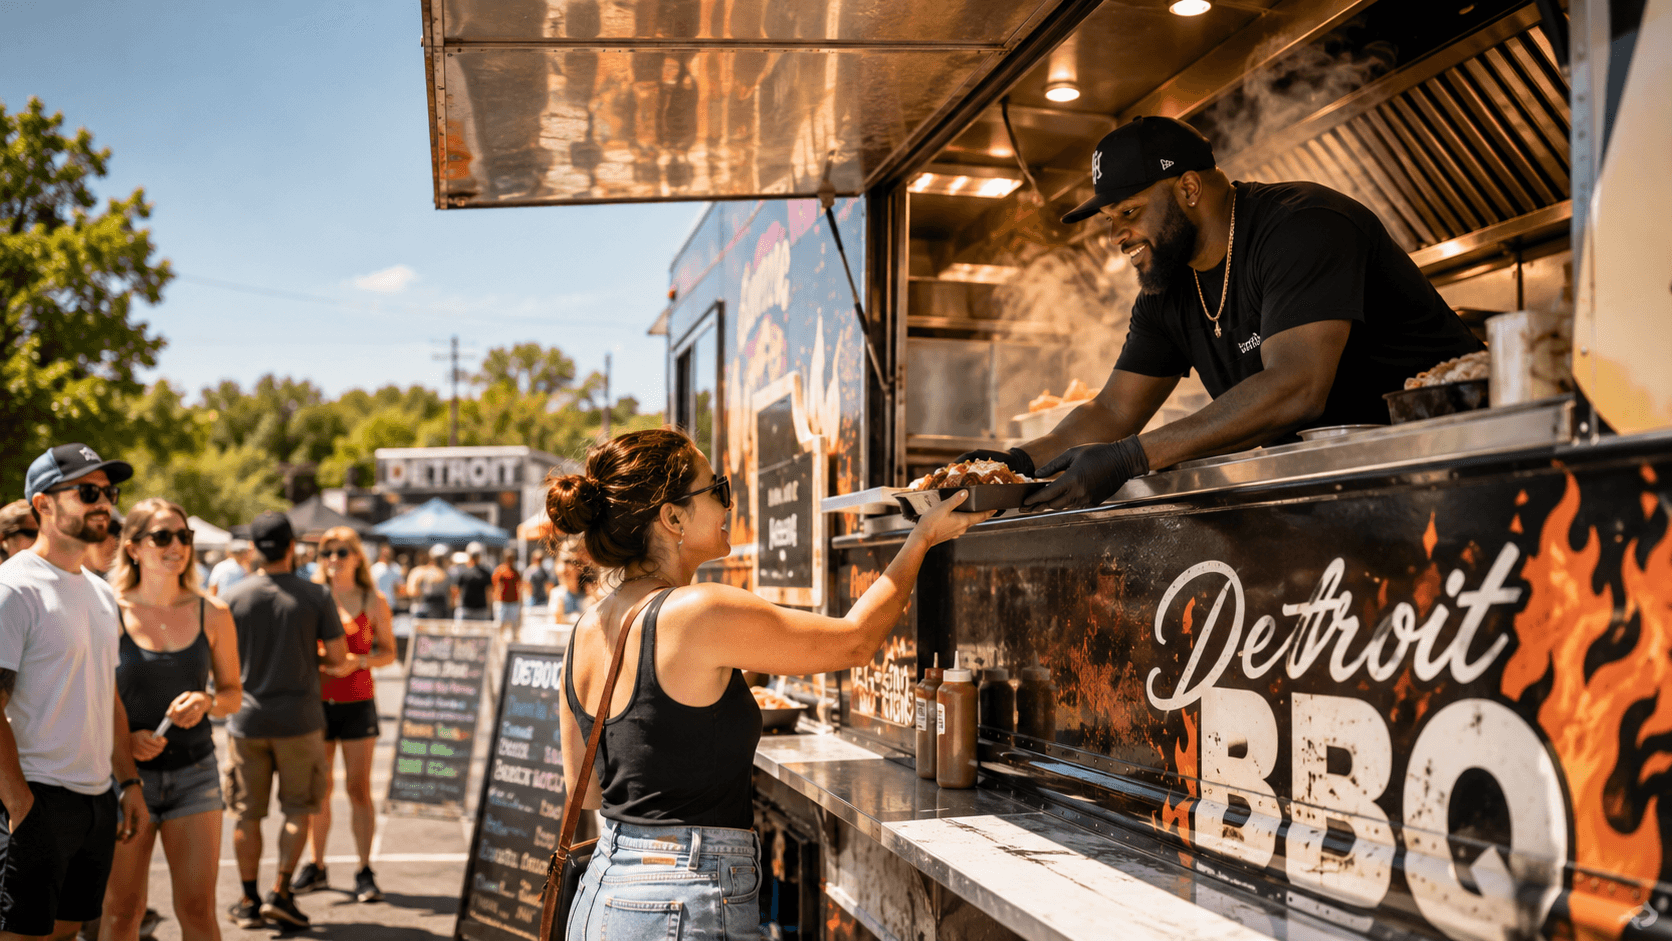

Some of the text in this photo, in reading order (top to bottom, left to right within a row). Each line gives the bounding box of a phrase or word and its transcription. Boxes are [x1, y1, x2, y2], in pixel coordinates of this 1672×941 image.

[386, 457, 521, 488] DETROIT
[1146, 541, 1523, 711] Detroit
[1194, 686, 1568, 941] BBQ
